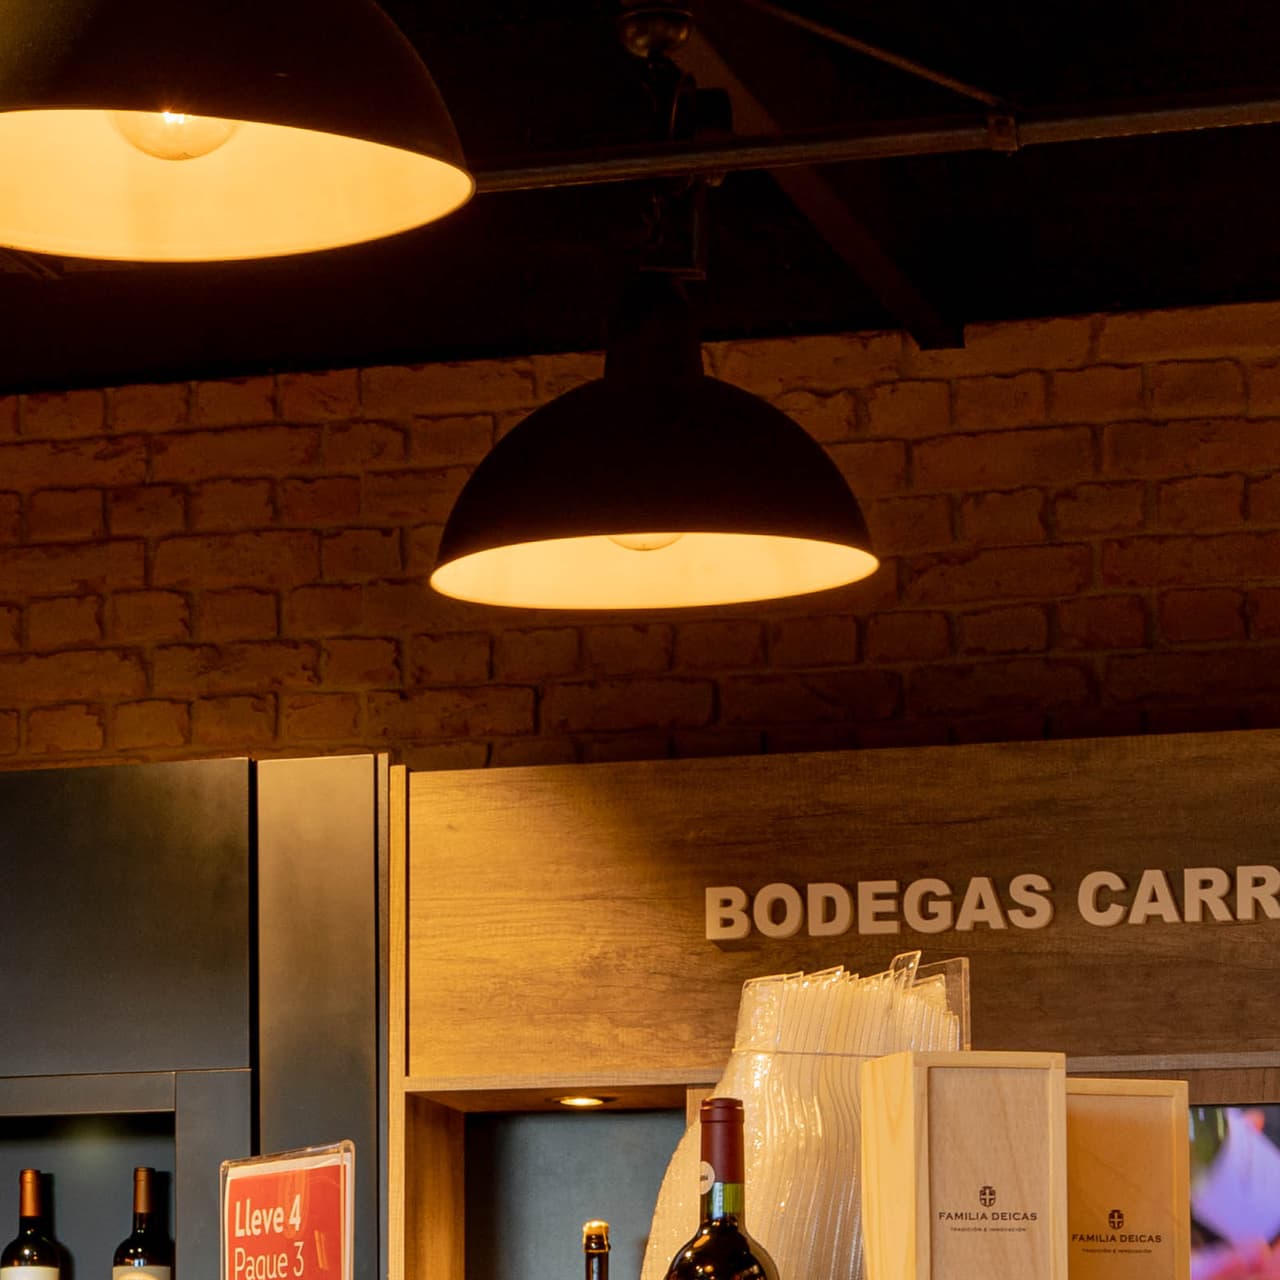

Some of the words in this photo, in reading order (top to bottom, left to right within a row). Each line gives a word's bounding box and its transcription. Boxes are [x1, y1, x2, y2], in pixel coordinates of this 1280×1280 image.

[704, 873, 1054, 941] BODEGAS
[234, 1200, 285, 1238] Lleve
[288, 1195, 301, 1233] 4
[938, 1212, 988, 1221] FAMILIA
[991, 1212, 1038, 1221] DEICAS
[1071, 1233, 1117, 1243] FAMILIA
[1119, 1234, 1162, 1243] DEICAS
[293, 1241, 305, 1278] 3
